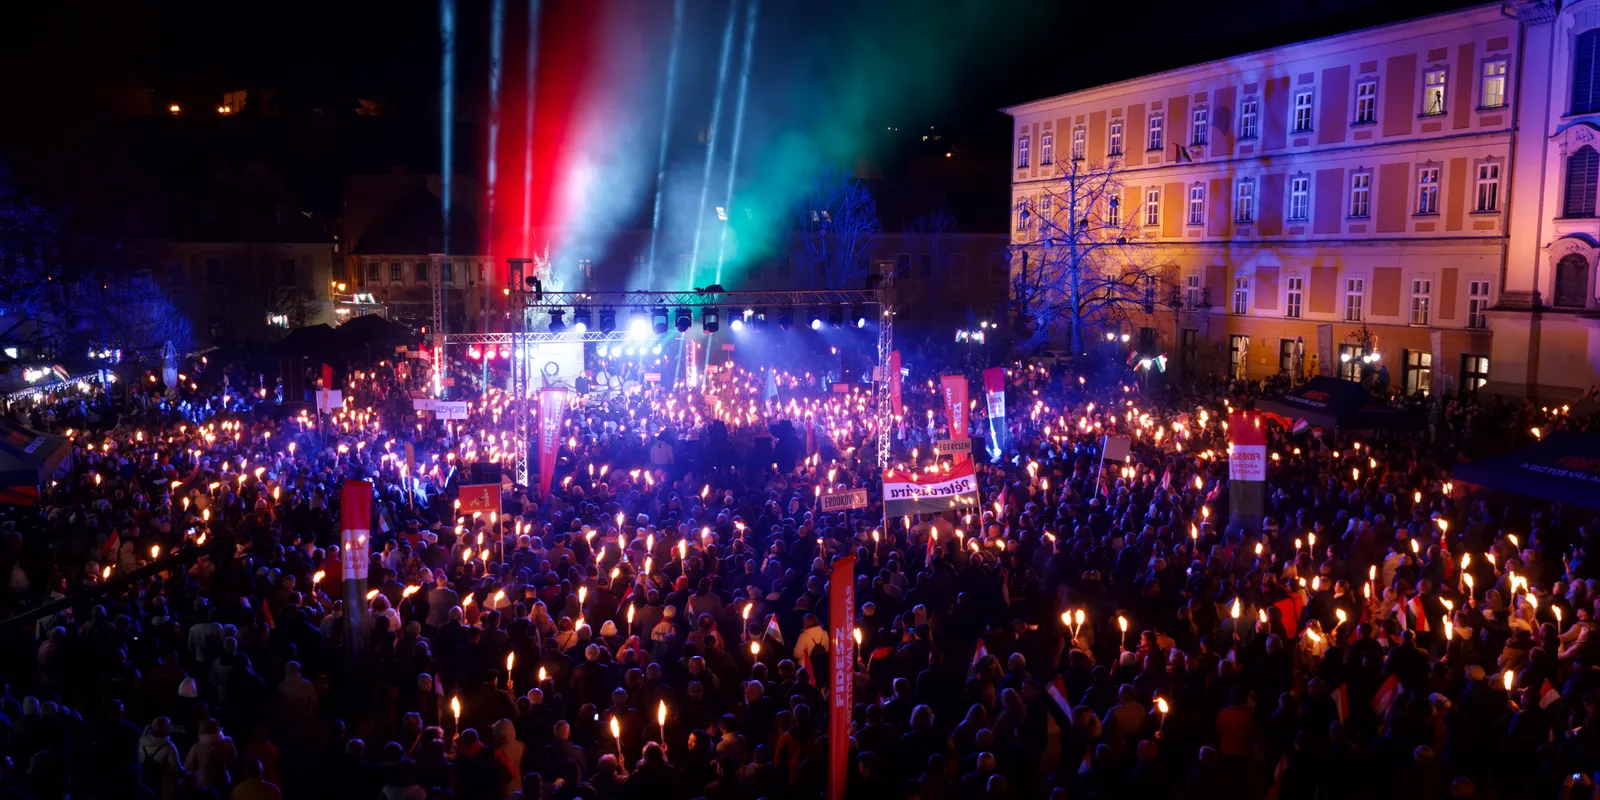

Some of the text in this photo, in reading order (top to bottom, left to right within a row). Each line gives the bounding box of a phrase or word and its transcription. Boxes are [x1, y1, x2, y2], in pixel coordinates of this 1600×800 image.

[544, 416, 553, 454] FIDESZ
[939, 442, 970, 451] EGERCSEHI
[1530, 464, 1569, 476] BIZTOS
[835, 626, 845, 708] FIDESZ
